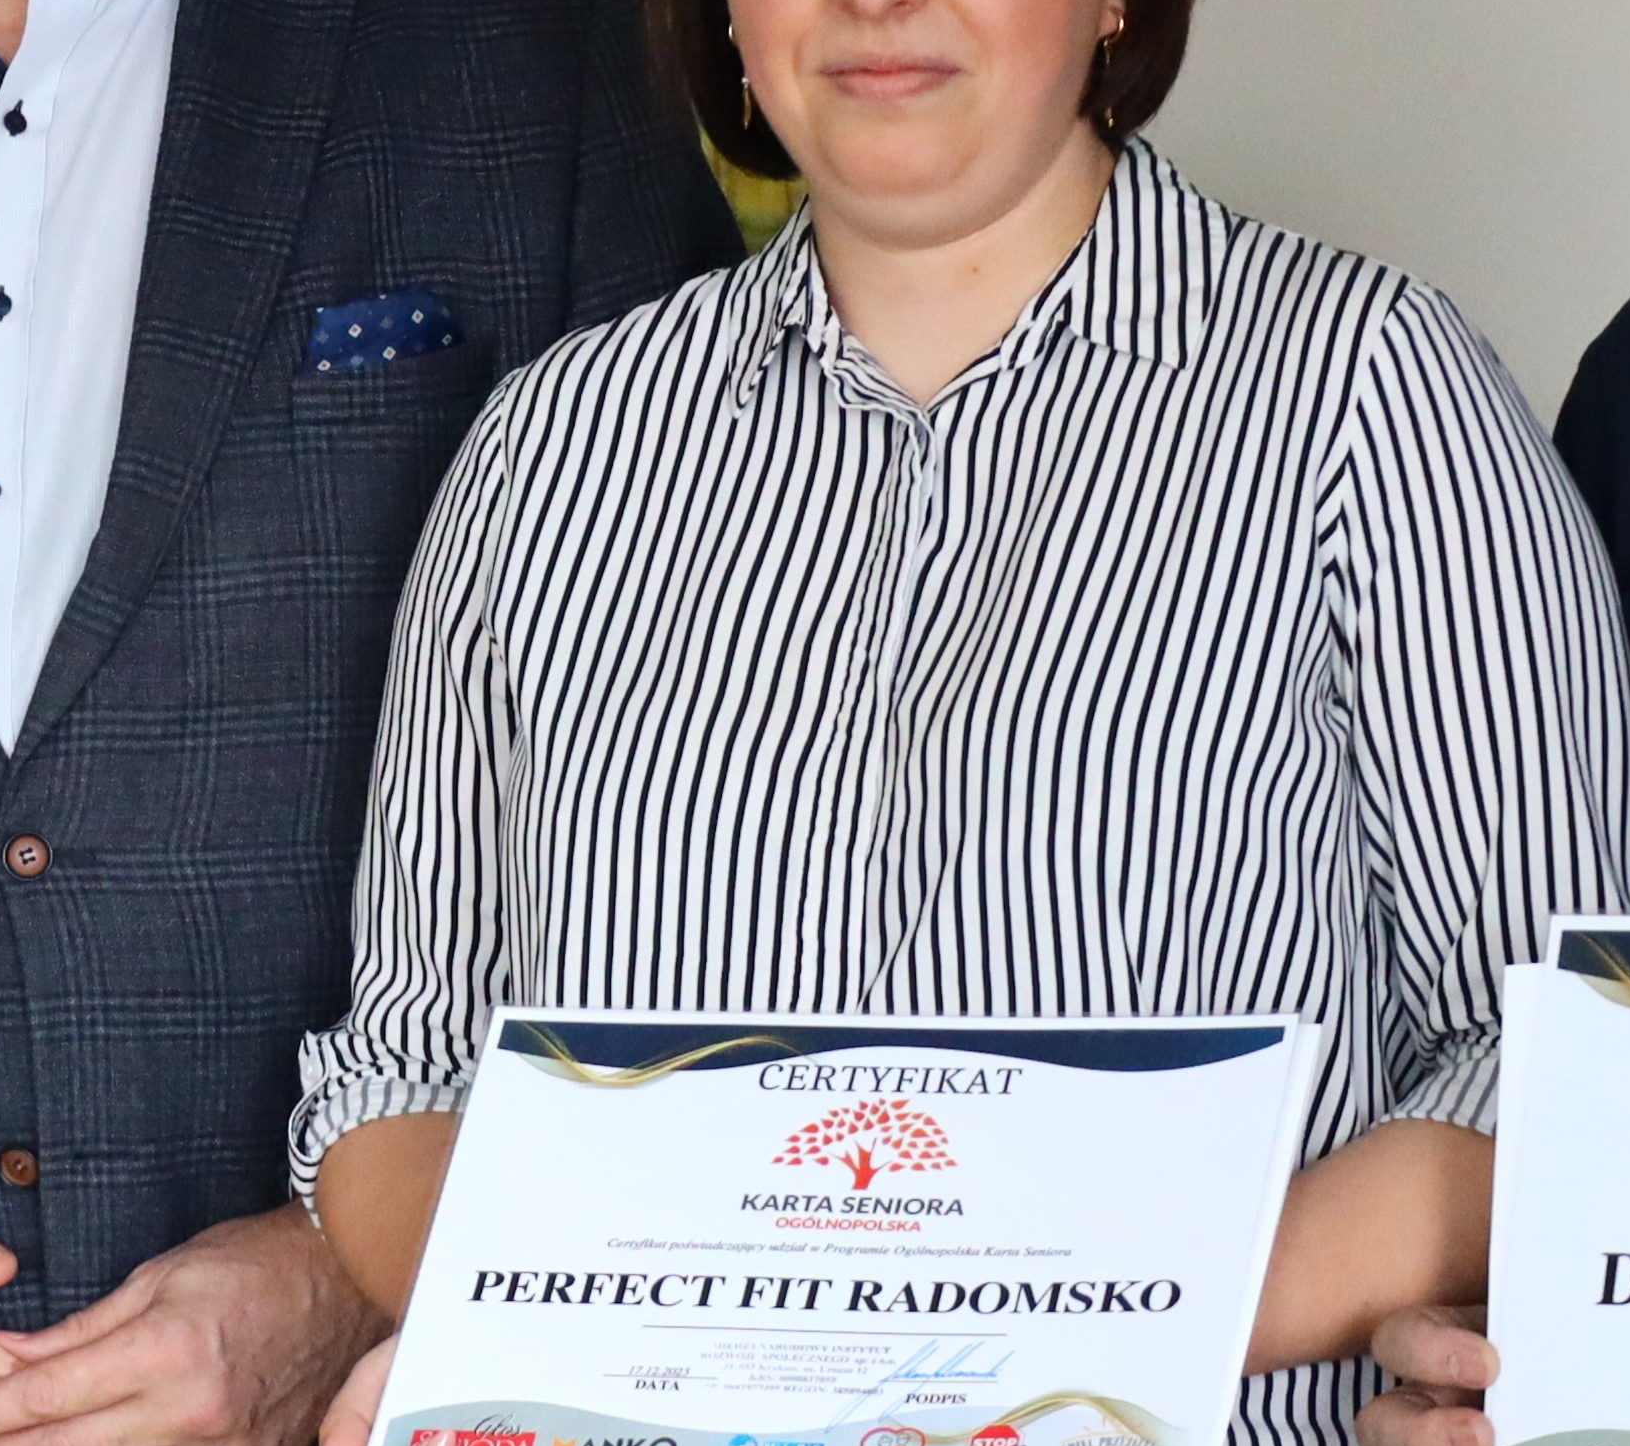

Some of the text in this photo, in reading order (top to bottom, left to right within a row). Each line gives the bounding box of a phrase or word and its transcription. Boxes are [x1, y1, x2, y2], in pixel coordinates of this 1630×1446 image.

[758, 1063, 1023, 1096] CERTYFIKAT
[741, 1193, 964, 1217] KARTA SENIORA
[775, 1214, 921, 1233] OGÓLNOPOLSKA
[607, 1237, 666, 1251] Certyfikat
[823, 1243, 890, 1256] Programie
[893, 1244, 980, 1258] Ogólnopolska
[983, 1246, 1019, 1257] Karta
[1023, 1246, 1072, 1257] Seniora
[467, 1270, 1182, 1314] PERFECT FIT RADOMSKO
[629, 1365, 691, 1377] 17.12.2025
[634, 1379, 680, 1391] DATA
[905, 1392, 967, 1405] PODPIS
